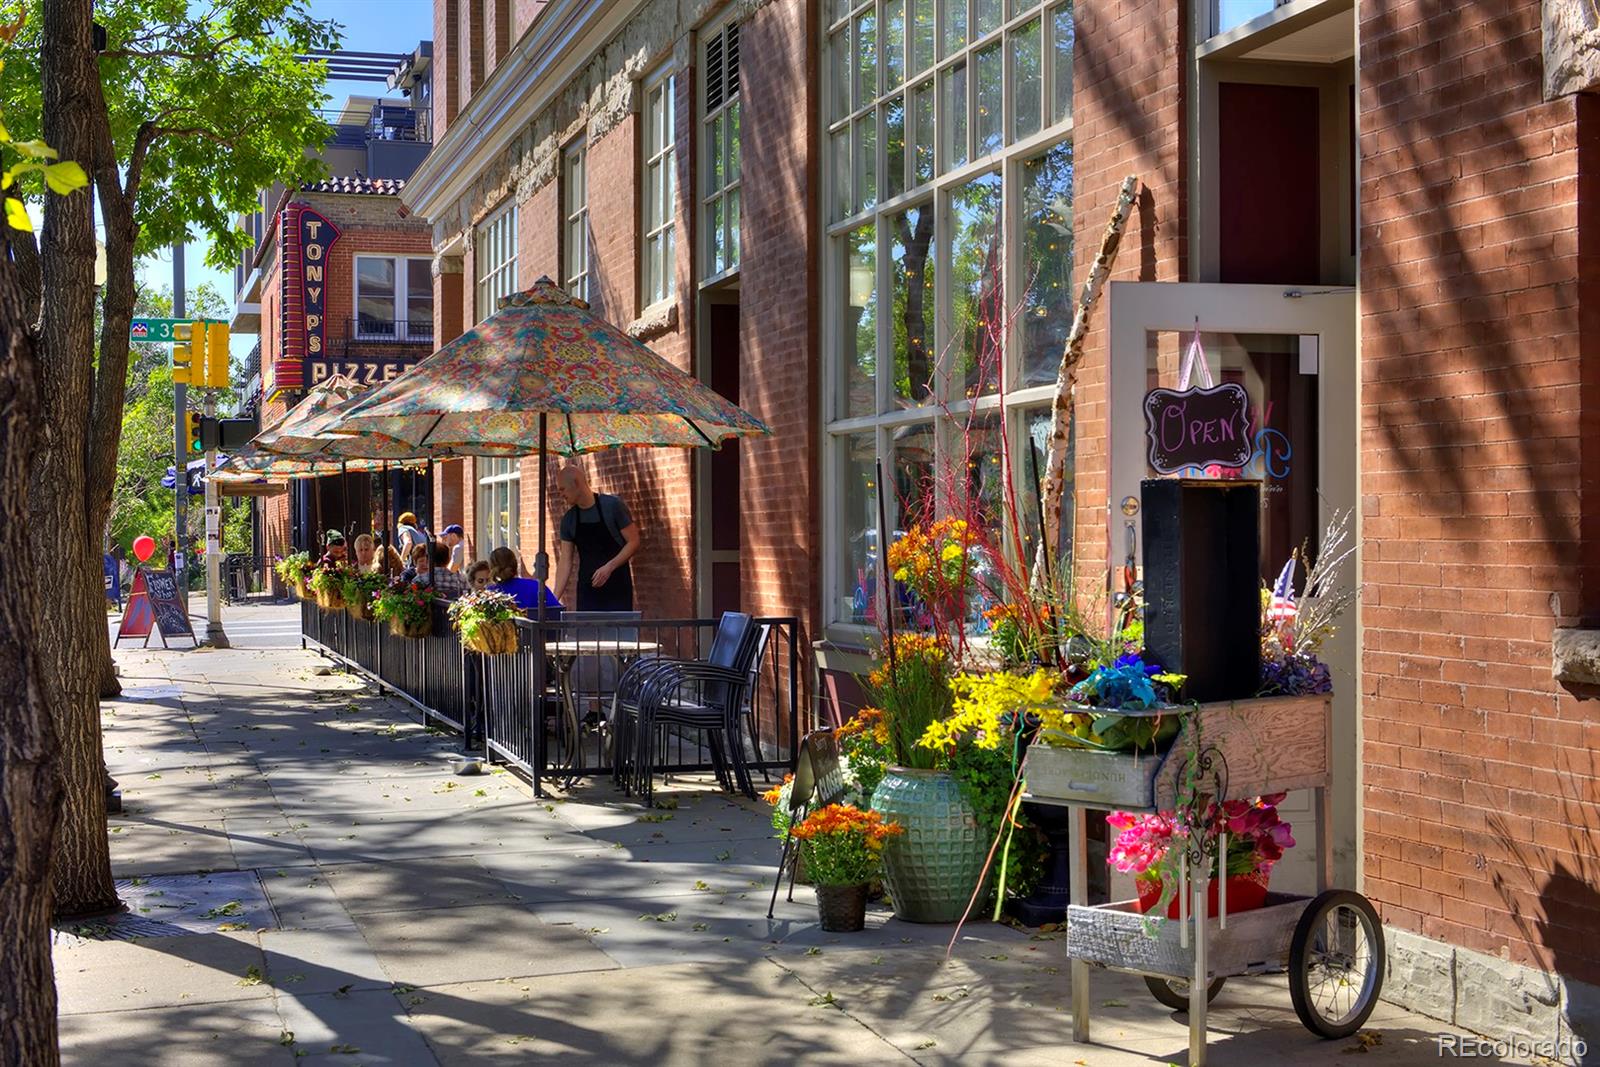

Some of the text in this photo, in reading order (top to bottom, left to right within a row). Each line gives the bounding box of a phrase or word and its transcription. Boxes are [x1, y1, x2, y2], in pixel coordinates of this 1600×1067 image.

[306, 221, 323, 304] TONY
[160, 323, 175, 338] 3
[1161, 402, 1239, 452] OPEN
